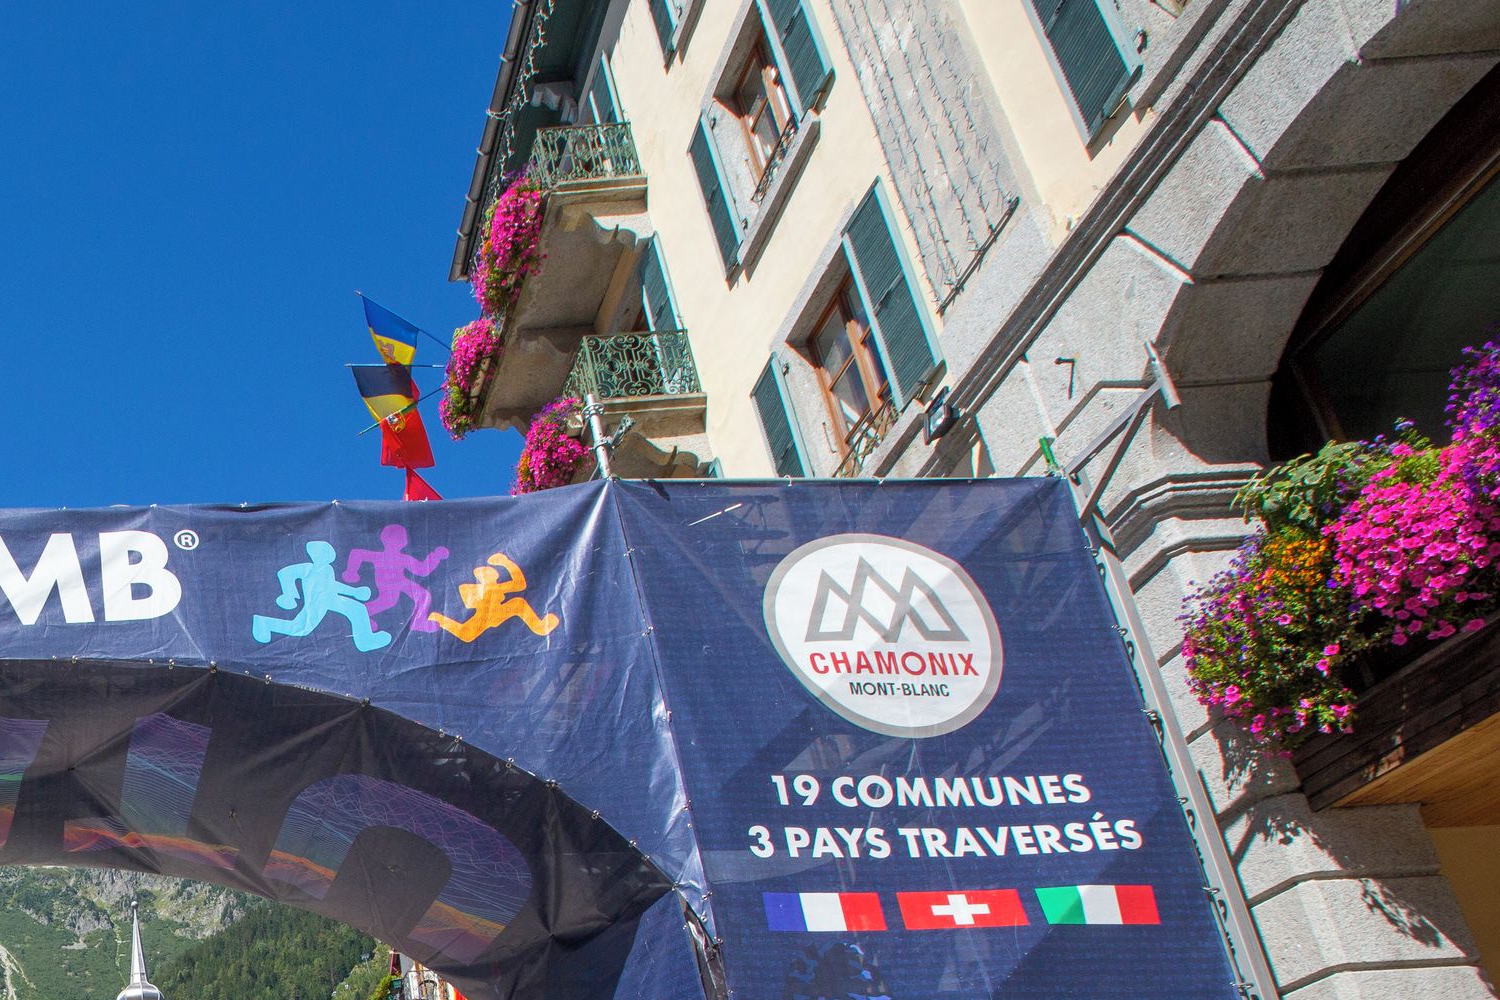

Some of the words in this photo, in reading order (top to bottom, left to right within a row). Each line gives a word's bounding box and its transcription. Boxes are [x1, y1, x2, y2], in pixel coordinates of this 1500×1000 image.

[809, 650, 980, 679] CHAMONIX
[849, 681, 951, 698] MONT-BLANC
[771, 774, 819, 807] 19
[832, 773, 1092, 808] COMMUNES
[748, 825, 775, 859] 3
[785, 825, 892, 860] PAYS
[898, 810, 1143, 858] TRAVERSÉS
